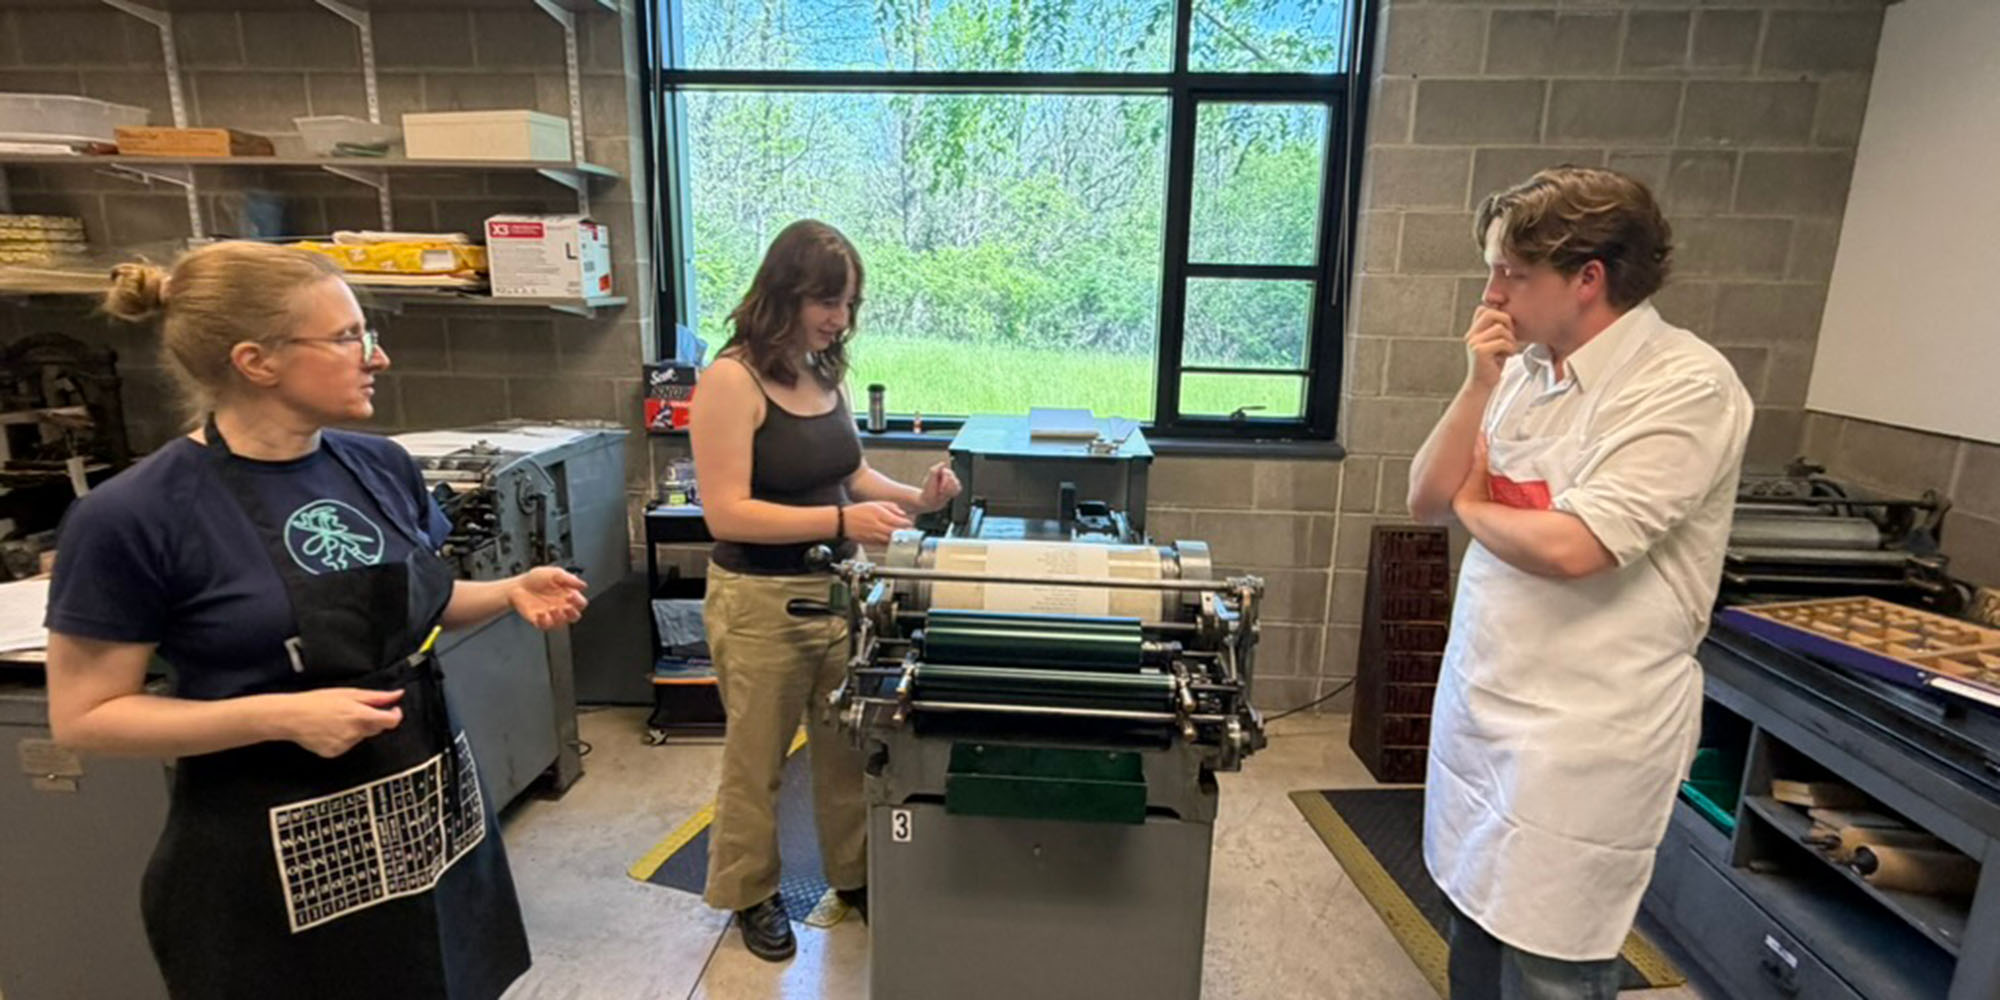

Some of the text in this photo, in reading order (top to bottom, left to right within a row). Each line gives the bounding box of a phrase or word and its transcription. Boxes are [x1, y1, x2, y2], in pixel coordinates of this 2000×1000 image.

[492, 224, 509, 236] X3
[566, 242, 578, 260] L
[896, 812, 908, 839] 3
